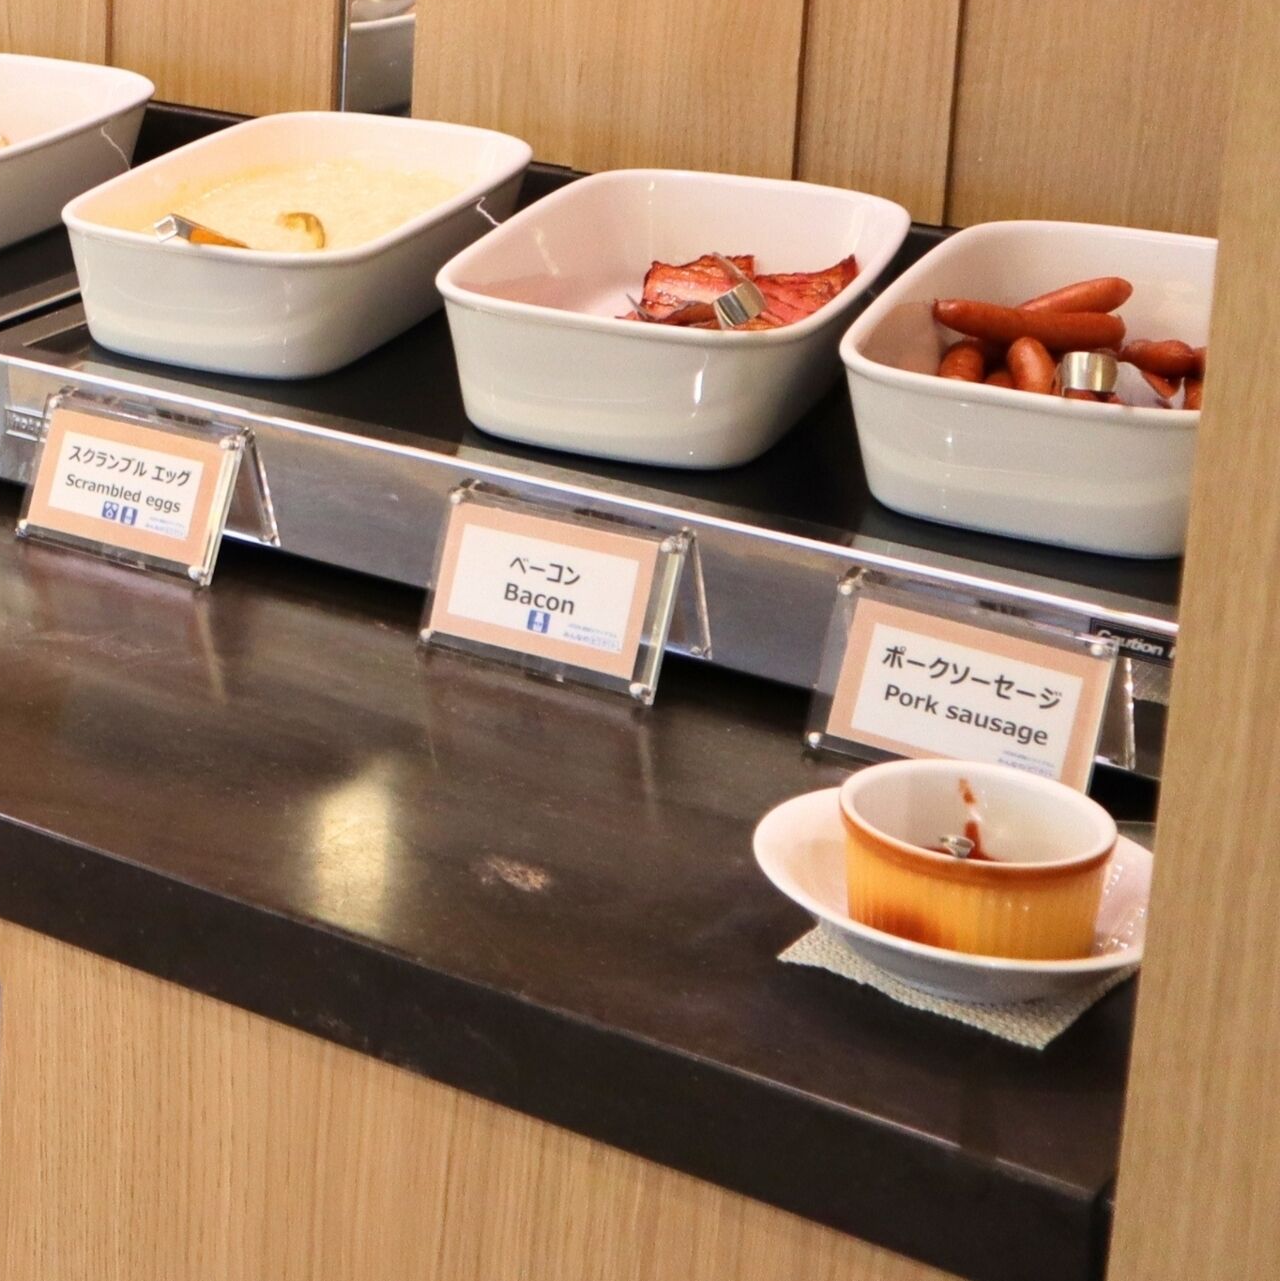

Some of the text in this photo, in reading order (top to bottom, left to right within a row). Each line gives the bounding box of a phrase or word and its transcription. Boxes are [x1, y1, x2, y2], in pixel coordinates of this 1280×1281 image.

[68, 445, 193, 487] スクランブル エッグ
[65, 473, 182, 514] Scrambled eggs
[509, 556, 581, 586] ベーコン
[503, 582, 575, 616] Bacon
[882, 645, 1063, 709] ポークソーセージ
[884, 683, 1049, 746] Pork sausage
